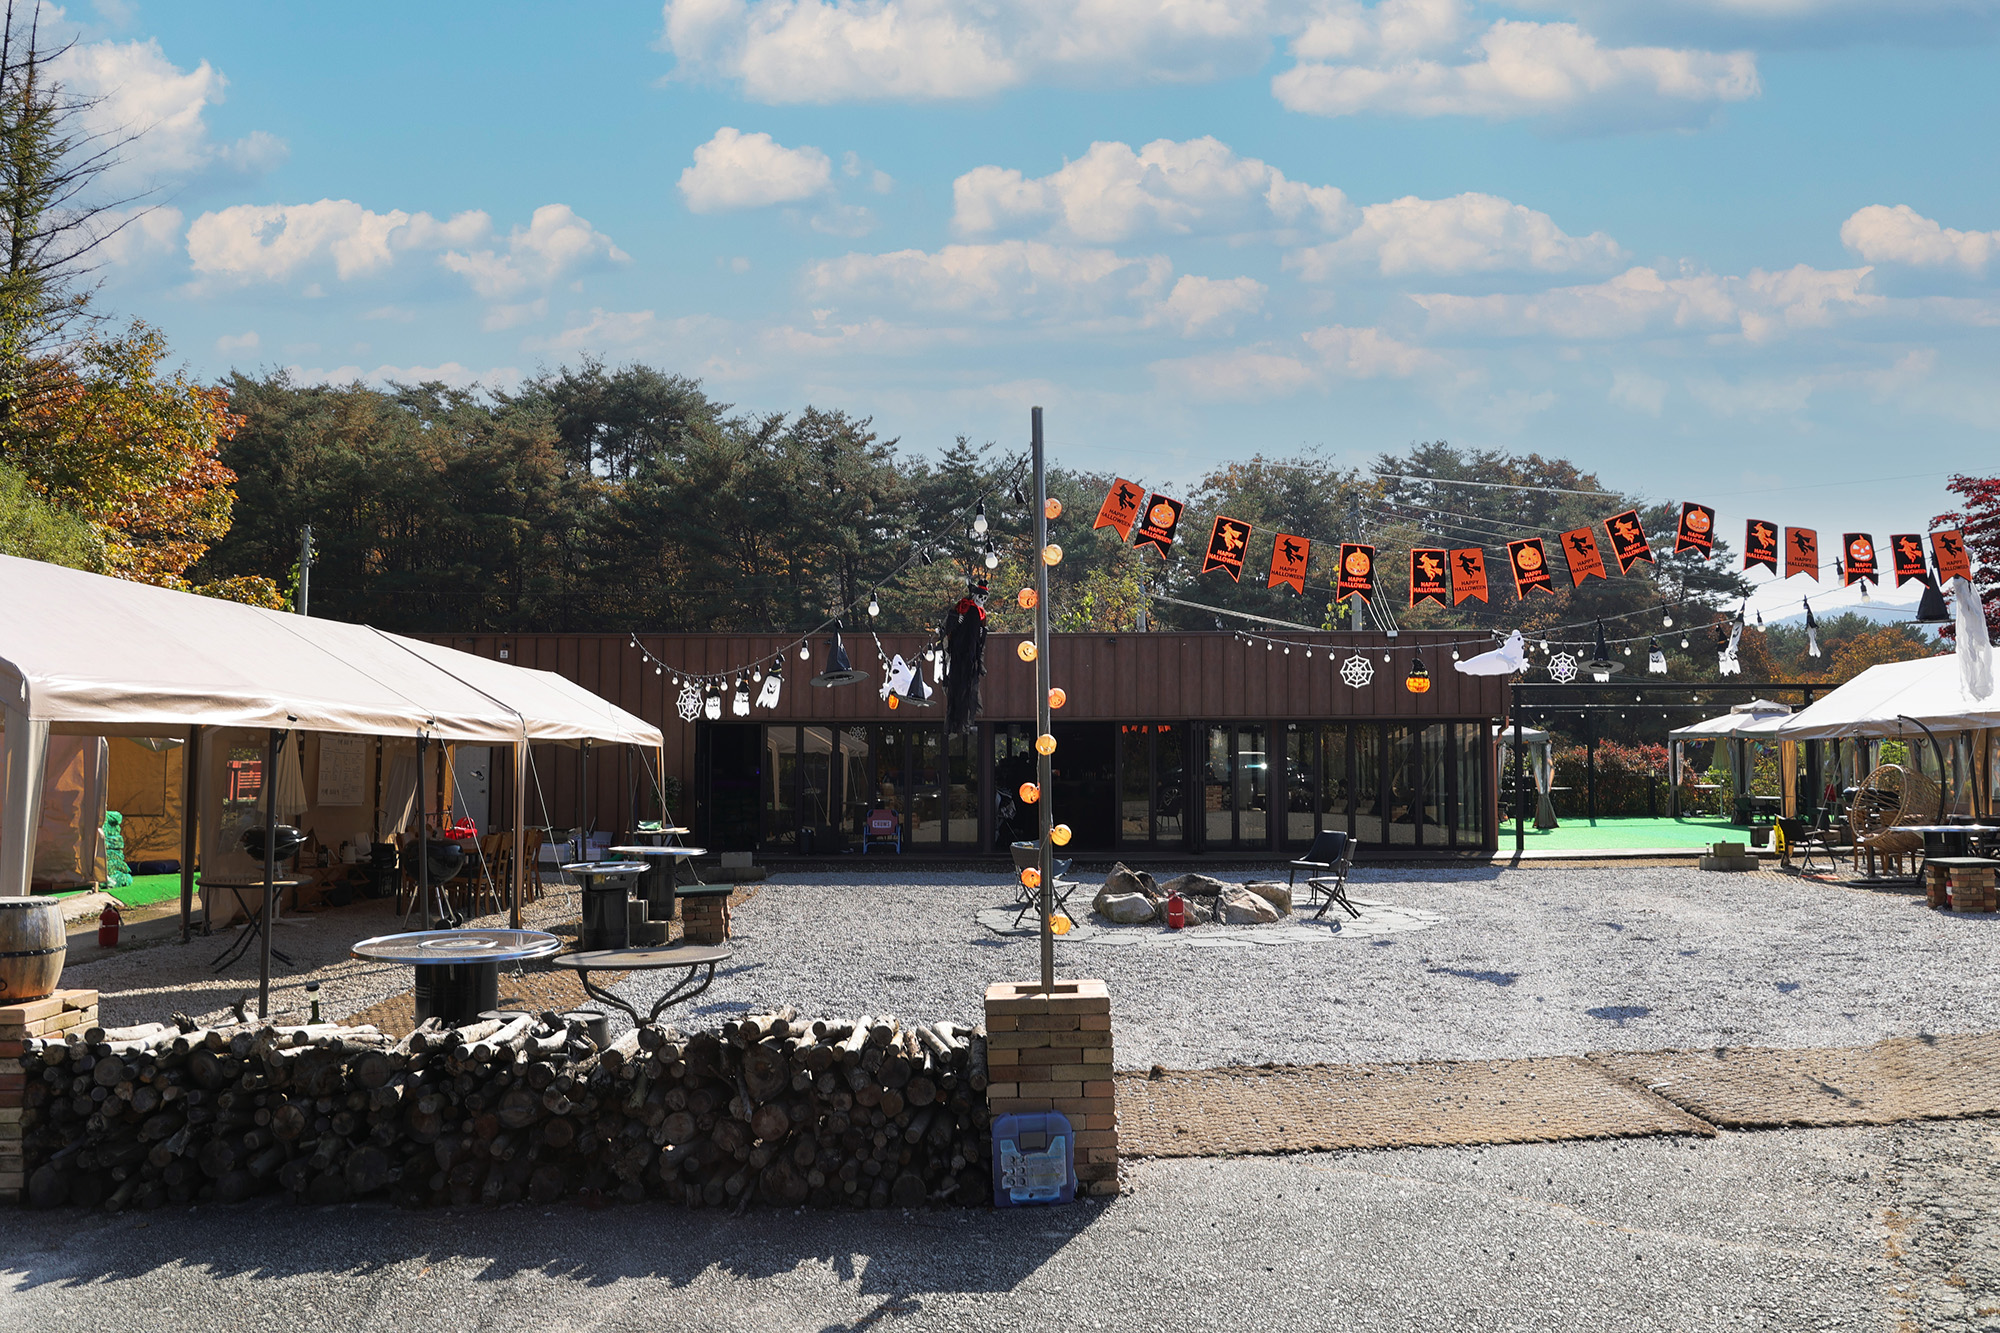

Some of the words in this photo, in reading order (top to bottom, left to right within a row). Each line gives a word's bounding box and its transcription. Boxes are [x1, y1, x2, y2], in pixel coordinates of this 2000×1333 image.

[1109, 508, 1127, 519] HAPPY
[1148, 525, 1167, 536] HAPPY
[1687, 531, 1706, 540] HAPPY
[1139, 529, 1172, 544] HALLOWEEN
[1680, 534, 1711, 547] HALLOWEEN
[1619, 545, 1649, 559] HALLOWEEN
[1623, 542, 1641, 552] HAPPY
[1754, 548, 1772, 556] HAPPY
[1217, 549, 1236, 559] HAPPY
[1746, 552, 1777, 562] HALLOWEEN
[1208, 553, 1242, 567] HALLOWEEN
[1577, 558, 1594, 566] HAPPY
[1279, 565, 1298, 573] HAPPY
[1572, 562, 1601, 574] HALLOWEEN
[1271, 570, 1304, 580] HALLOWEEN
[1524, 569, 1542, 578] HAPPY
[1518, 574, 1550, 584] HALLOWEEN
[1340, 581, 1372, 590] HALLOWEEN
